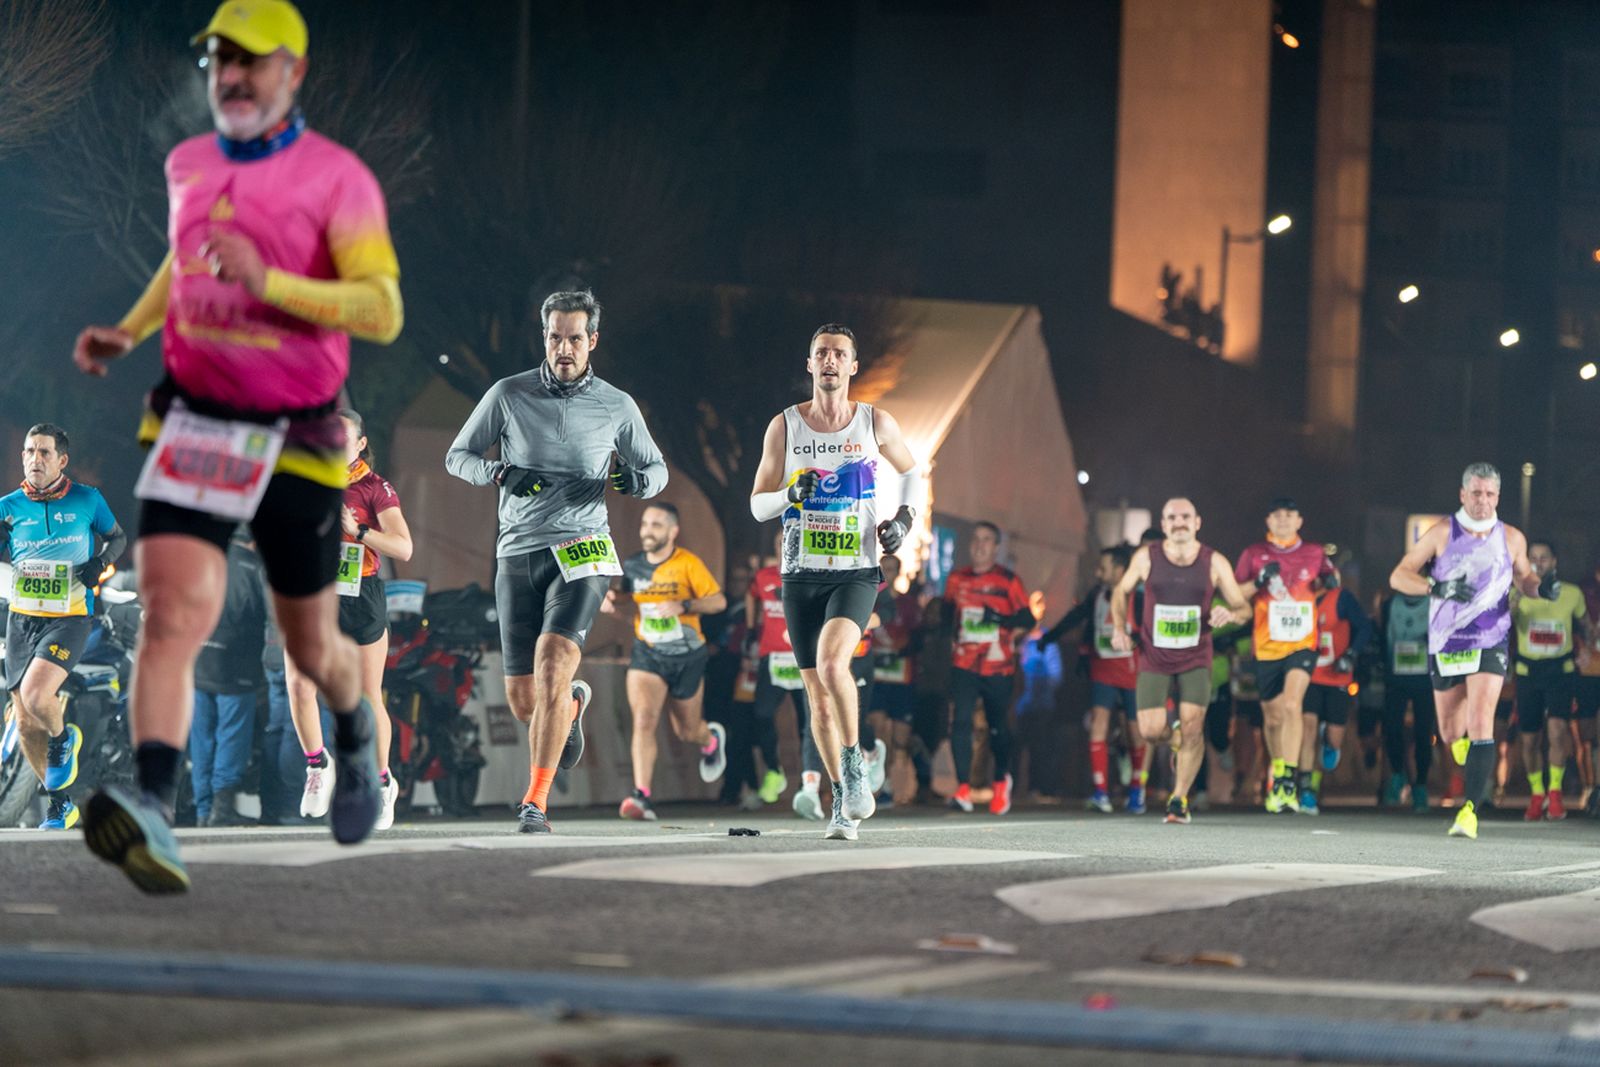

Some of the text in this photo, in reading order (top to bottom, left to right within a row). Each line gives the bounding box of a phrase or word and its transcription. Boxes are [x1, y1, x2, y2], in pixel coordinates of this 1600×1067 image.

[793, 439, 862, 459] calderón
[566, 540, 608, 561] 5649
[810, 531, 854, 550] 13312
